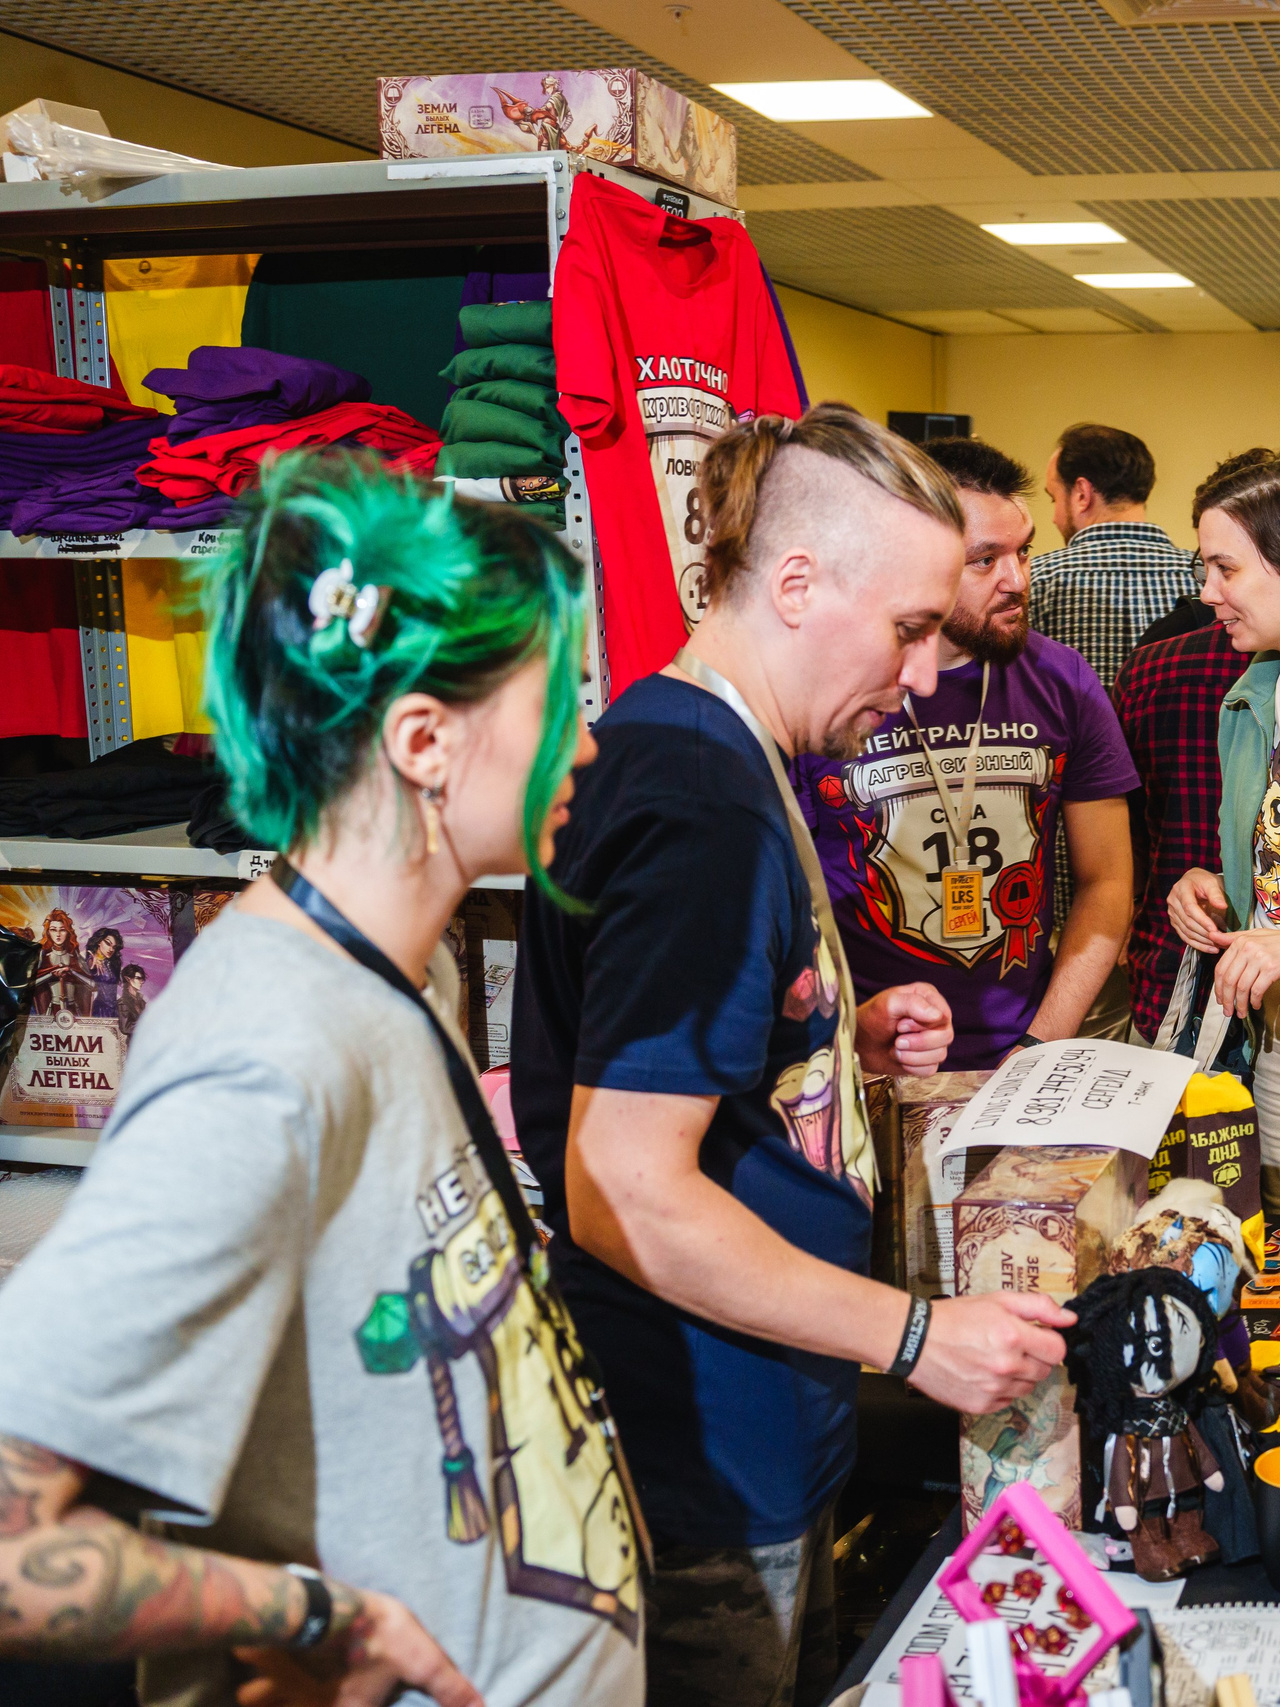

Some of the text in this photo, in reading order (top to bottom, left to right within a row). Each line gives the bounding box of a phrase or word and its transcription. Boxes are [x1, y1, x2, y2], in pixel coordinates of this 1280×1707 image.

[417, 103, 457, 114] ЗЕМЛИ
[415, 124, 461, 134] ЛЕГЕНД
[922, 826, 1004, 883] 18
[952, 890, 974, 904] LRS
[949, 909, 979, 930] СЕРГЕЙ
[29, 1034, 104, 1053] ЗЕМЛИ
[46, 1056, 90, 1067] БЫЛЫХ
[27, 1070, 114, 1090] ЛЕГЕНД
[1207, 1141, 1241, 1165] ДНД
